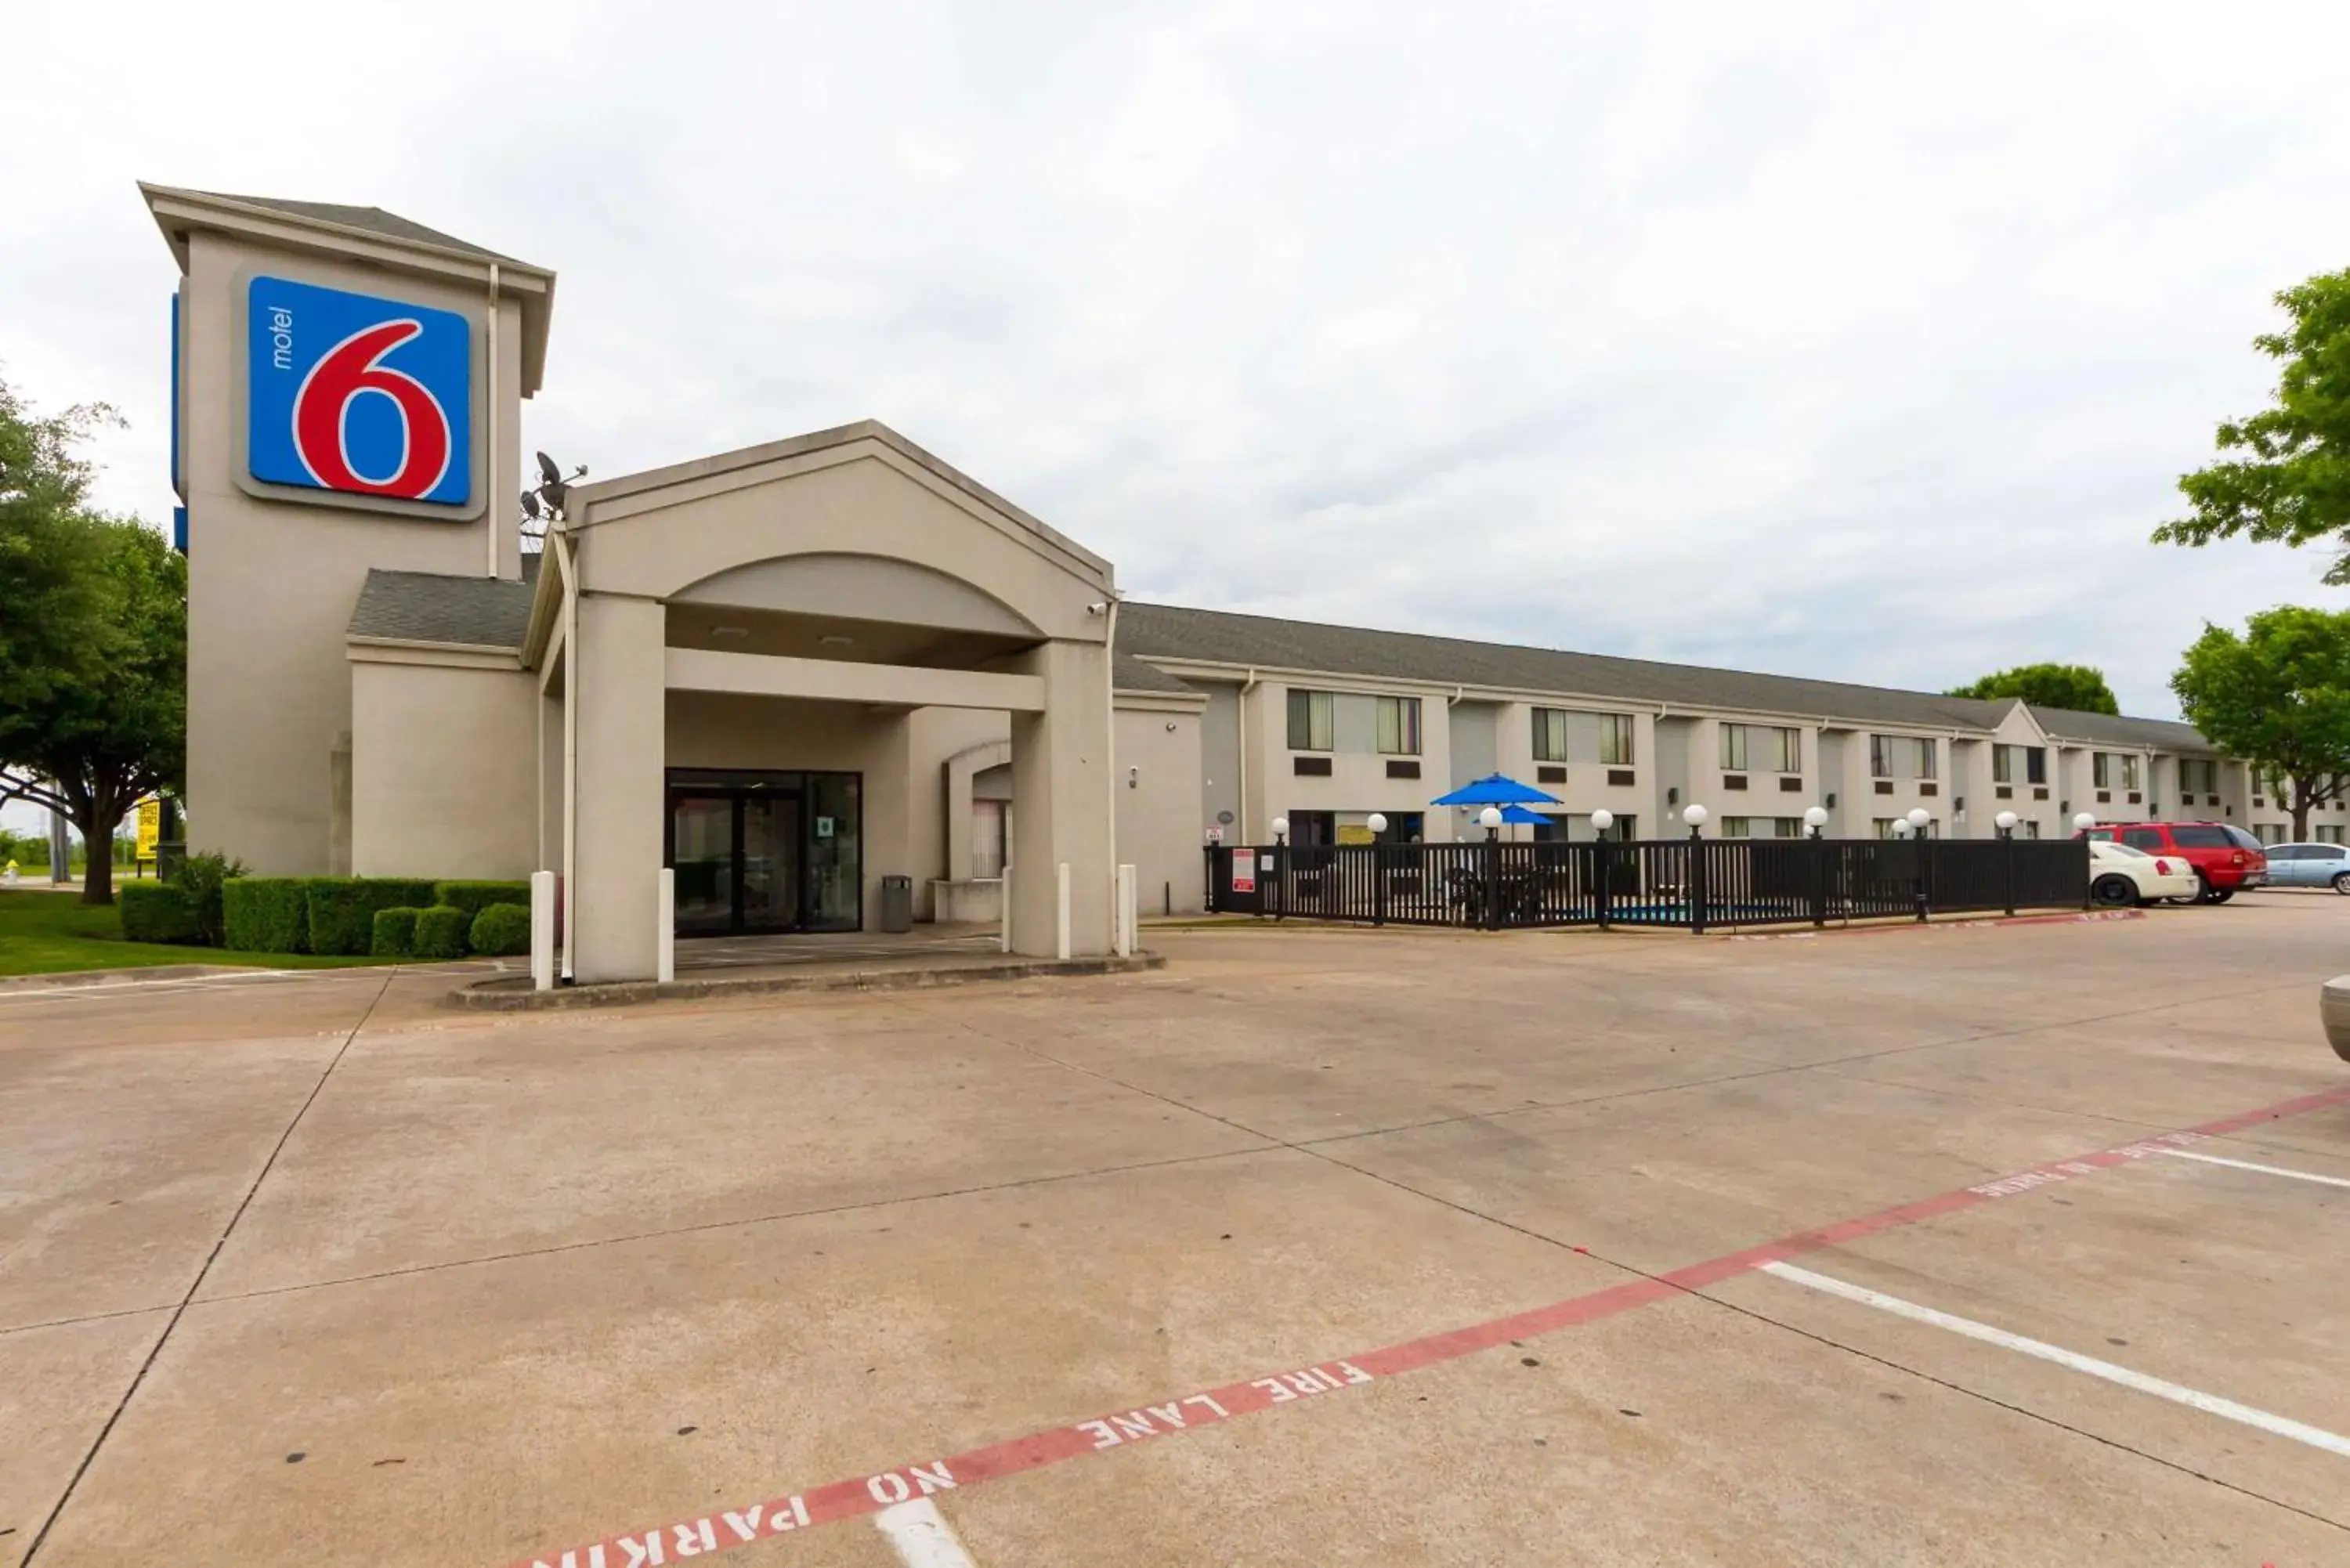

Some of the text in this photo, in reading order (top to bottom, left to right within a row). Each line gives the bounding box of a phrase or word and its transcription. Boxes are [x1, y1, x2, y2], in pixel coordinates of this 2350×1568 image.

[268, 305, 293, 370] motel
[291, 318, 452, 499] 6
[1251, 1360, 1374, 1403] FIRE
[1077, 1394, 1230, 1449] LANE
[867, 1461, 958, 1503] NO
